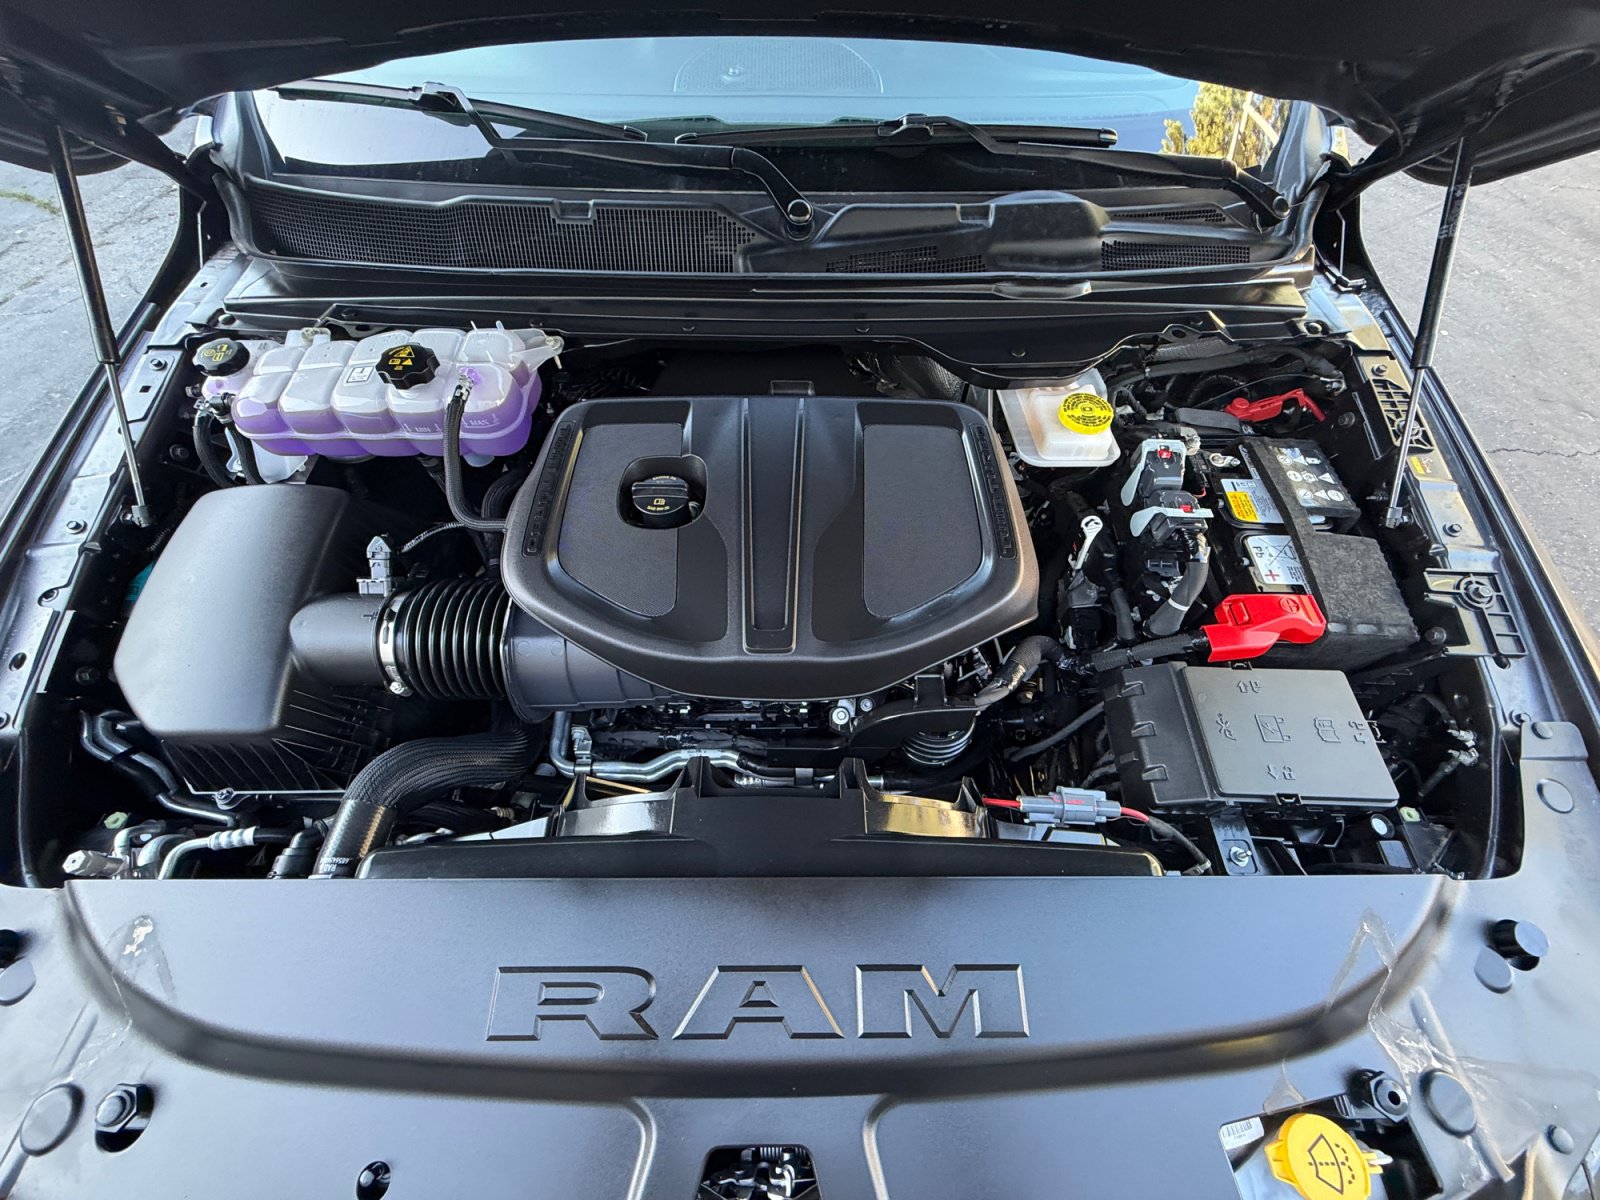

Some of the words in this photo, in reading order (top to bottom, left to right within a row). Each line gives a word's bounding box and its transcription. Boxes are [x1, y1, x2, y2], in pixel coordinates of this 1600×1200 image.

[975, 424, 1001, 495] TURBO
[1252, 546, 1264, 558] Pb
[486, 964, 1031, 1041] RAM
